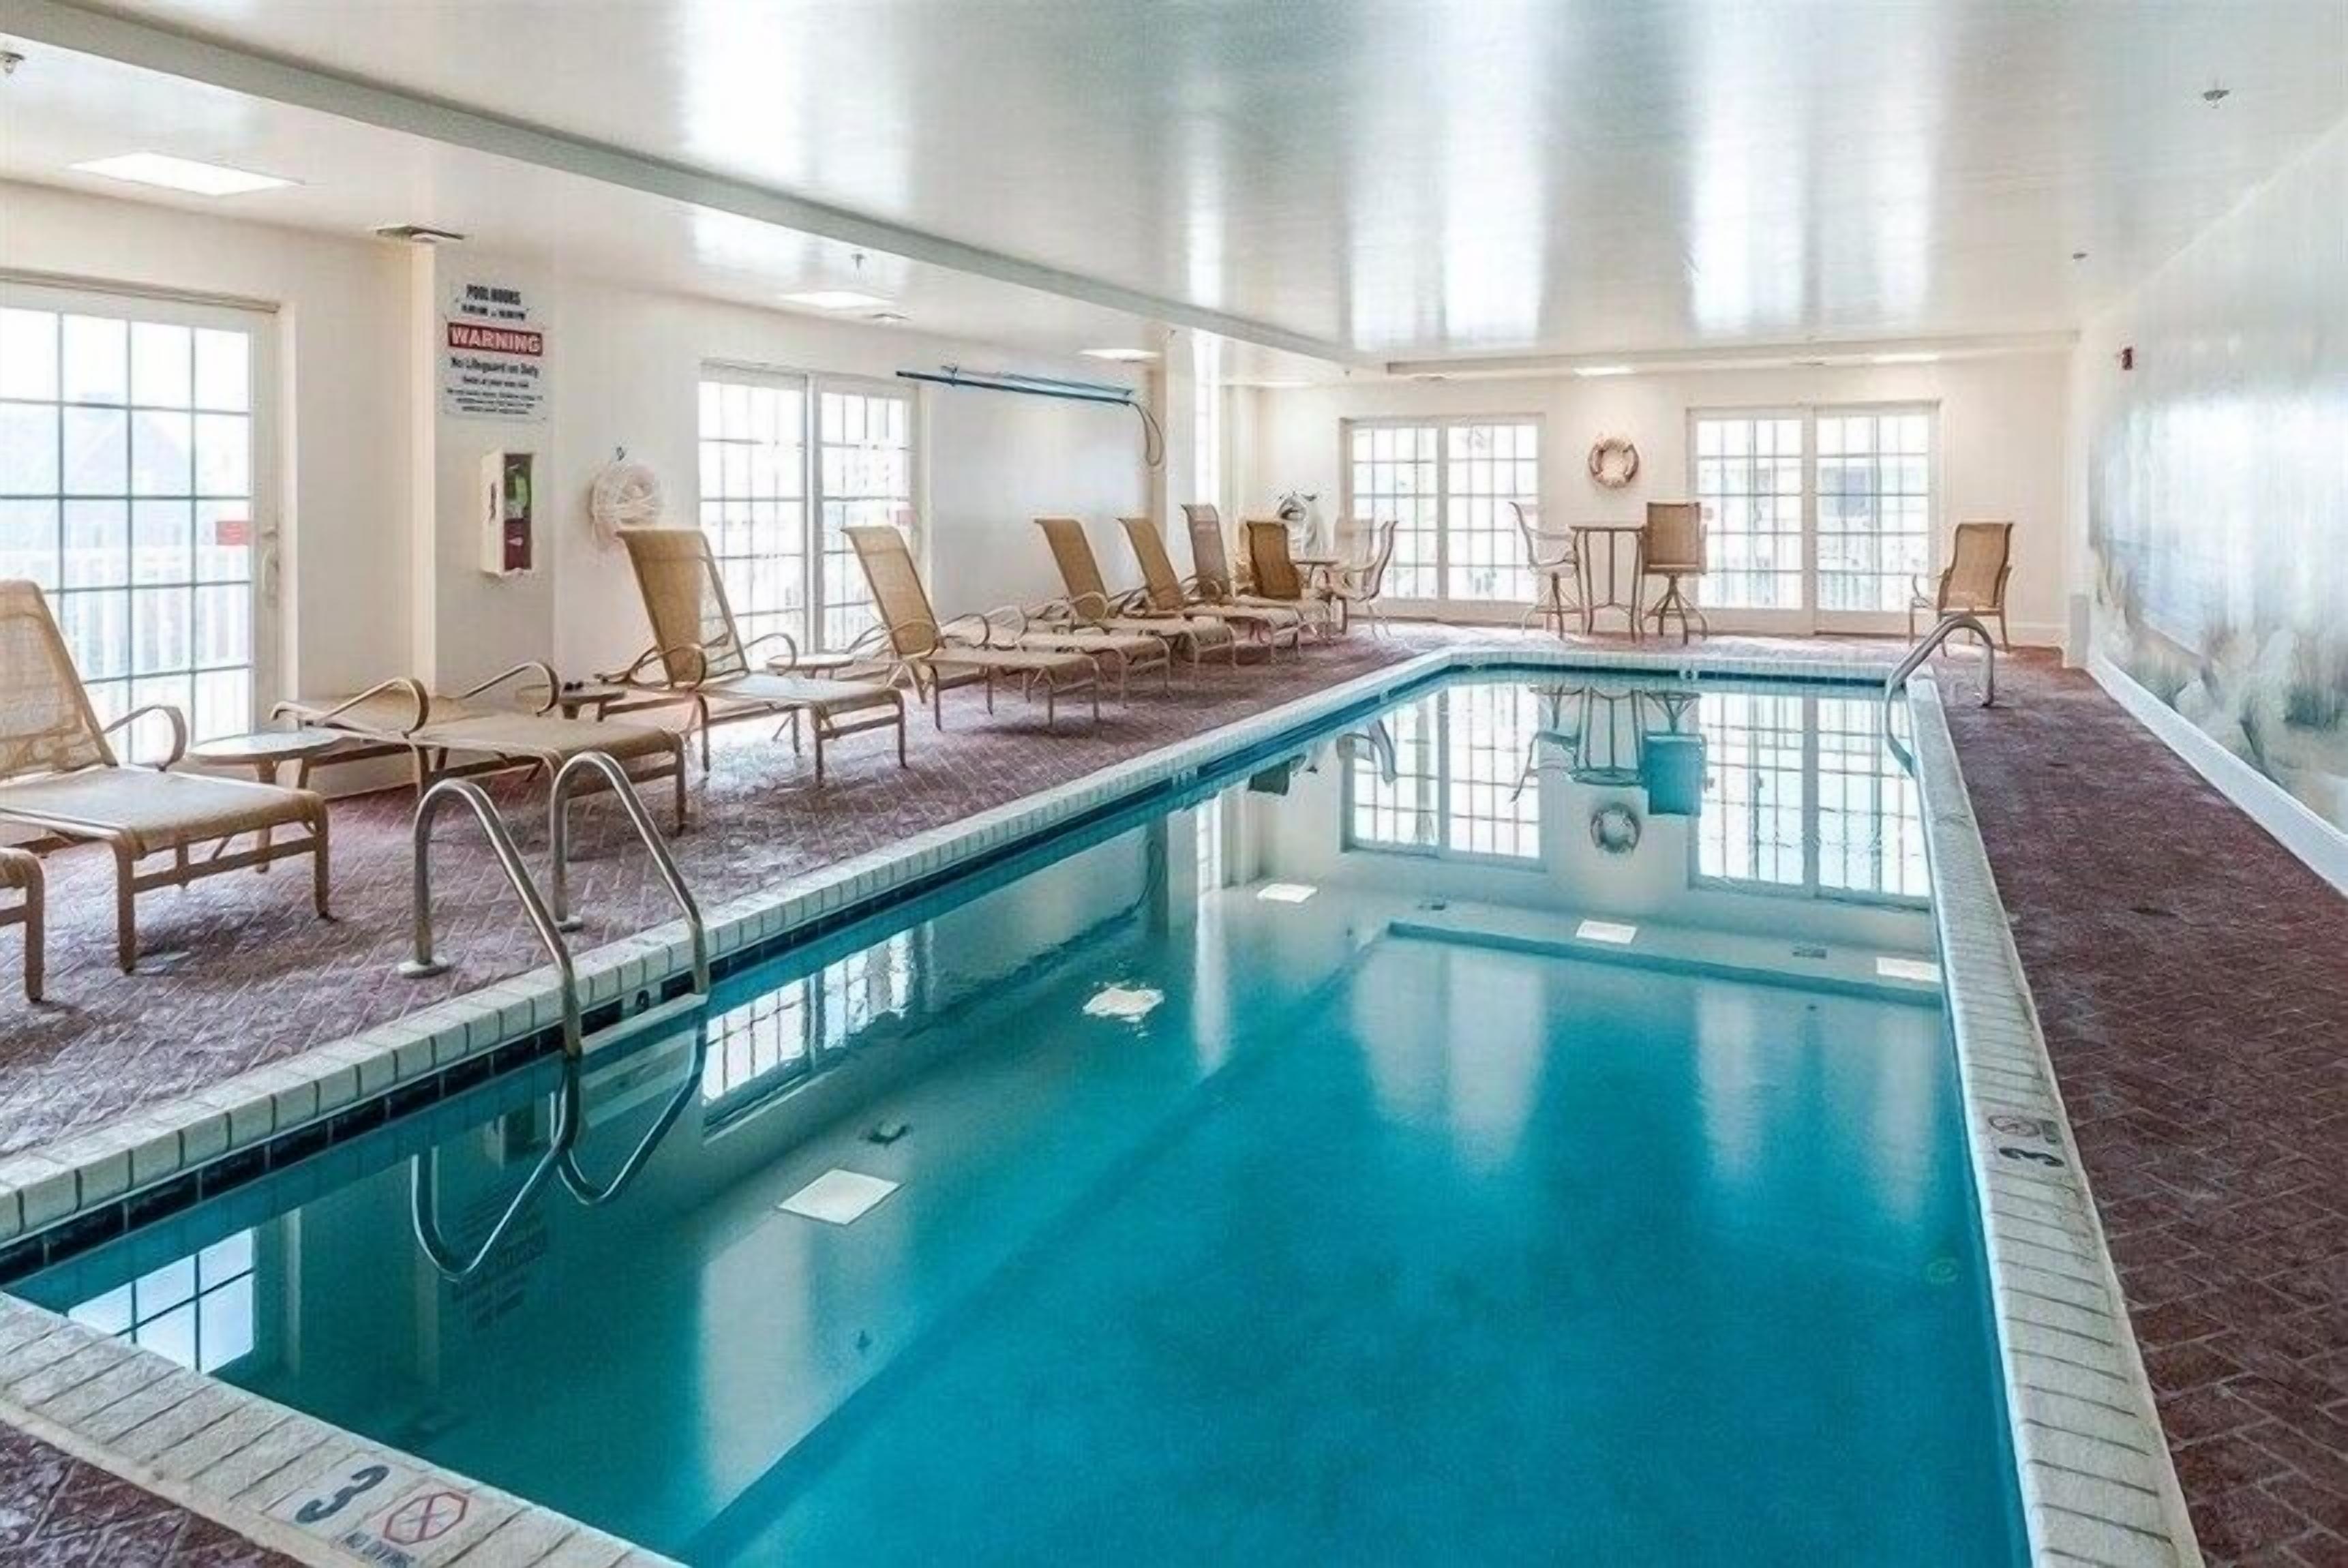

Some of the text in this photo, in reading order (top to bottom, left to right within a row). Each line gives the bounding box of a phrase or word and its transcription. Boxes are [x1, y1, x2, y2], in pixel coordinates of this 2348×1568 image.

[452, 326, 541, 353] WARNING
[451, 357, 464, 369] No
[295, 1465, 390, 1524] 3
